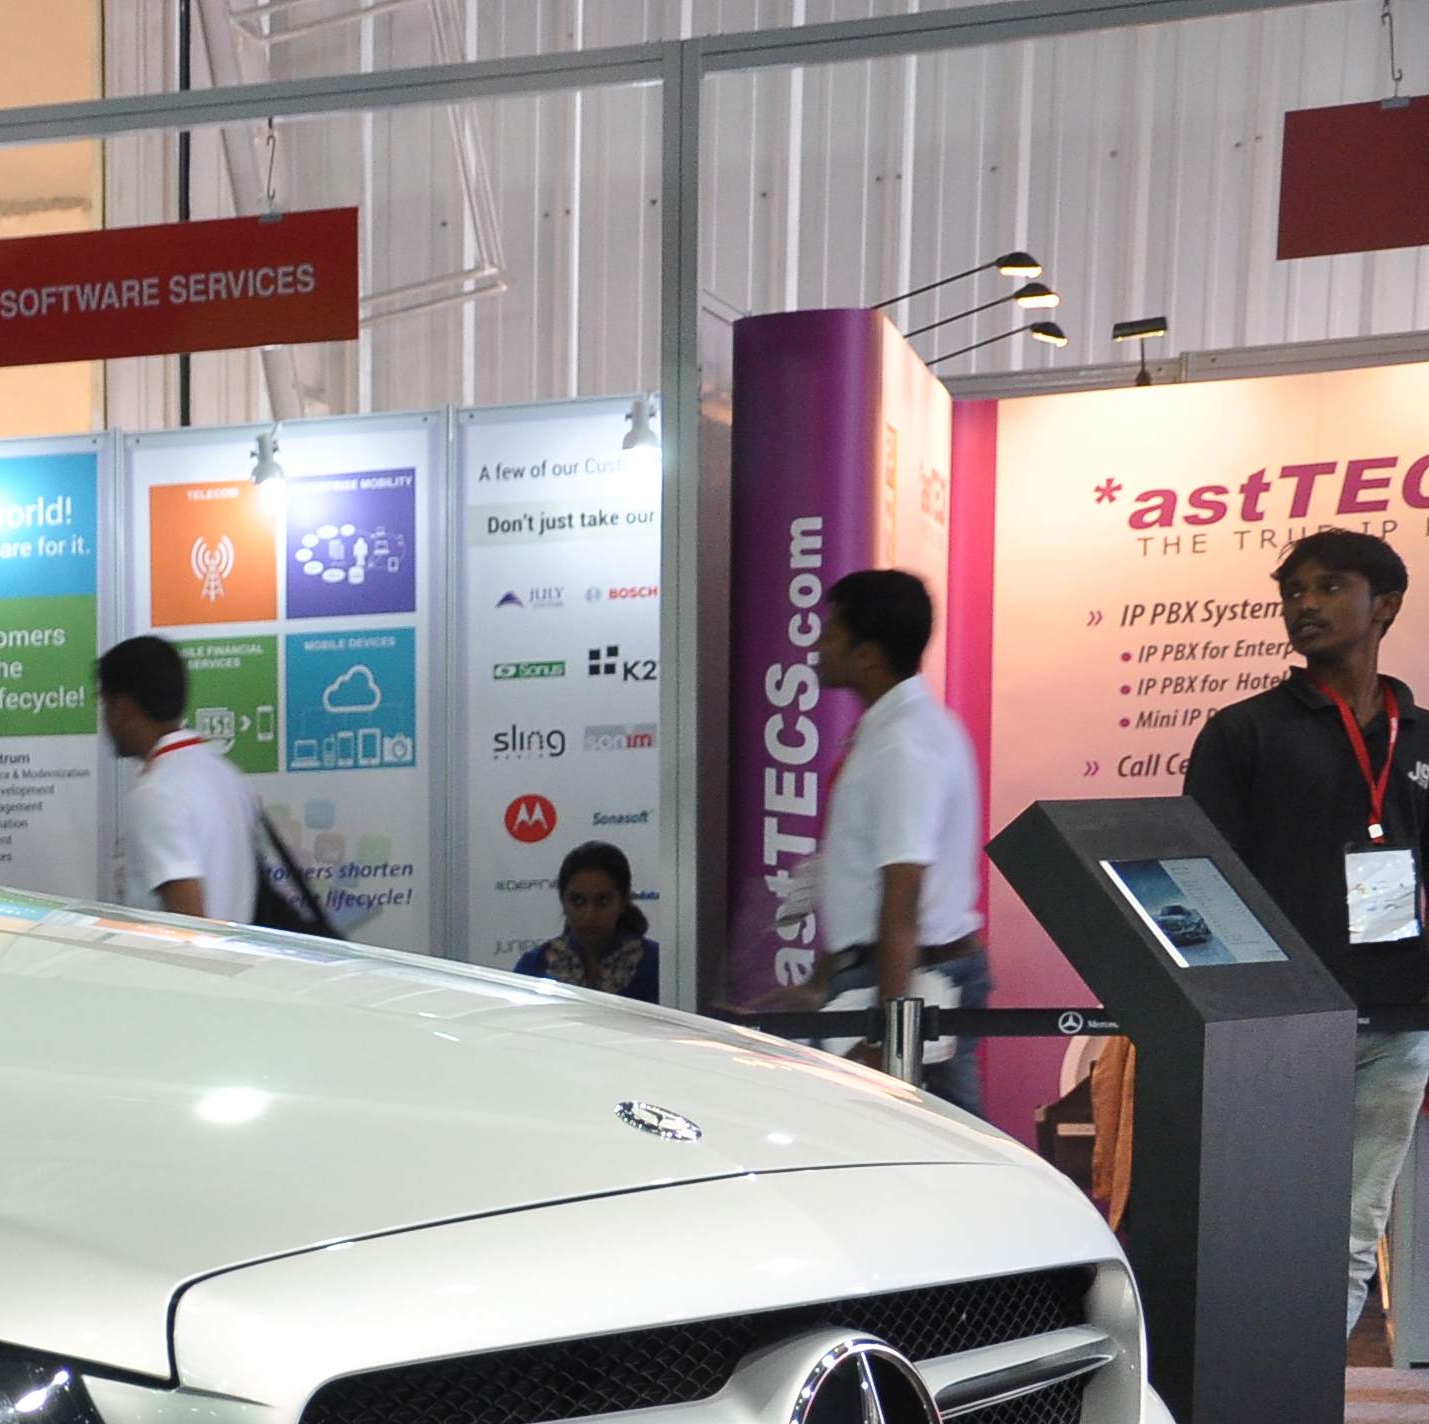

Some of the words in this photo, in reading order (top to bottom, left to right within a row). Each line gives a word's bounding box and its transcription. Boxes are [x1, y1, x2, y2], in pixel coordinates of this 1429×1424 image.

[0, 276, 161, 319] SOFTWARE
[169, 264, 316, 306] SERVICES
[479, 467, 490, 481] A
[496, 462, 525, 480] few
[530, 460, 548, 478] of
[551, 462, 579, 477] our
[488, 513, 534, 535] Don't
[539, 511, 573, 535] just
[581, 509, 619, 528] take
[626, 510, 656, 525] our
[37, 535, 65, 556] for
[1137, 533, 1208, 557] THE
[608, 586, 659, 600] BOSCH
[1120, 604, 1145, 627] IP
[1150, 601, 1201, 626] PBX
[1138, 646, 1158, 664] IP
[1161, 642, 1198, 662] PBX
[1200, 641, 1229, 661] for
[1234, 639, 1294, 659] Enterp
[623, 660, 657, 682] K2
[1137, 677, 1158, 696] IP
[1160, 675, 1197, 695] PBX
[1199, 674, 1229, 696] for
[1136, 709, 1177, 729] Mini
[1182, 708, 1201, 727] IP
[494, 724, 565, 757] sling
[1117, 754, 1159, 778] Call
[339, 862, 413, 879] shorten
[326, 887, 413, 911] lifecycle!
